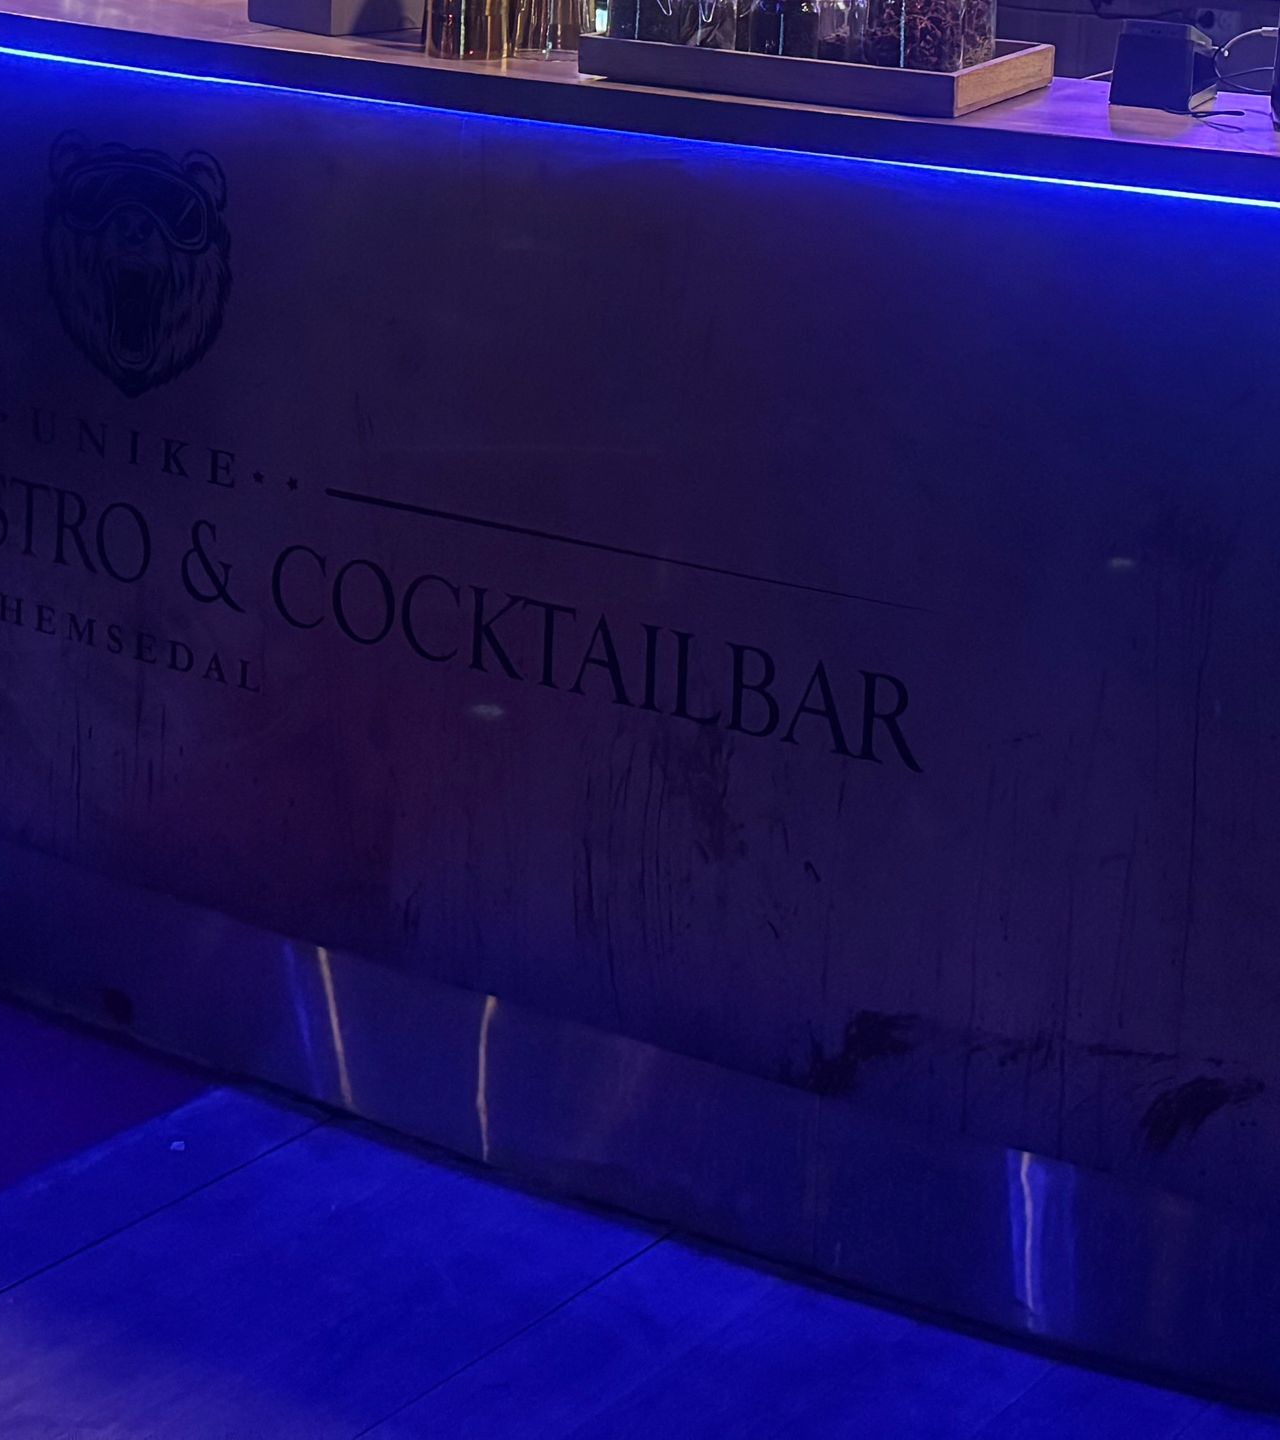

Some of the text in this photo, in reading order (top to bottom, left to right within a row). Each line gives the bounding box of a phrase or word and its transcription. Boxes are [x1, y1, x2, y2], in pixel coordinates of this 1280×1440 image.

[32, 406, 237, 490] UNIKE
[181, 519, 246, 614] &
[271, 544, 924, 774] COCKTAILBAR
